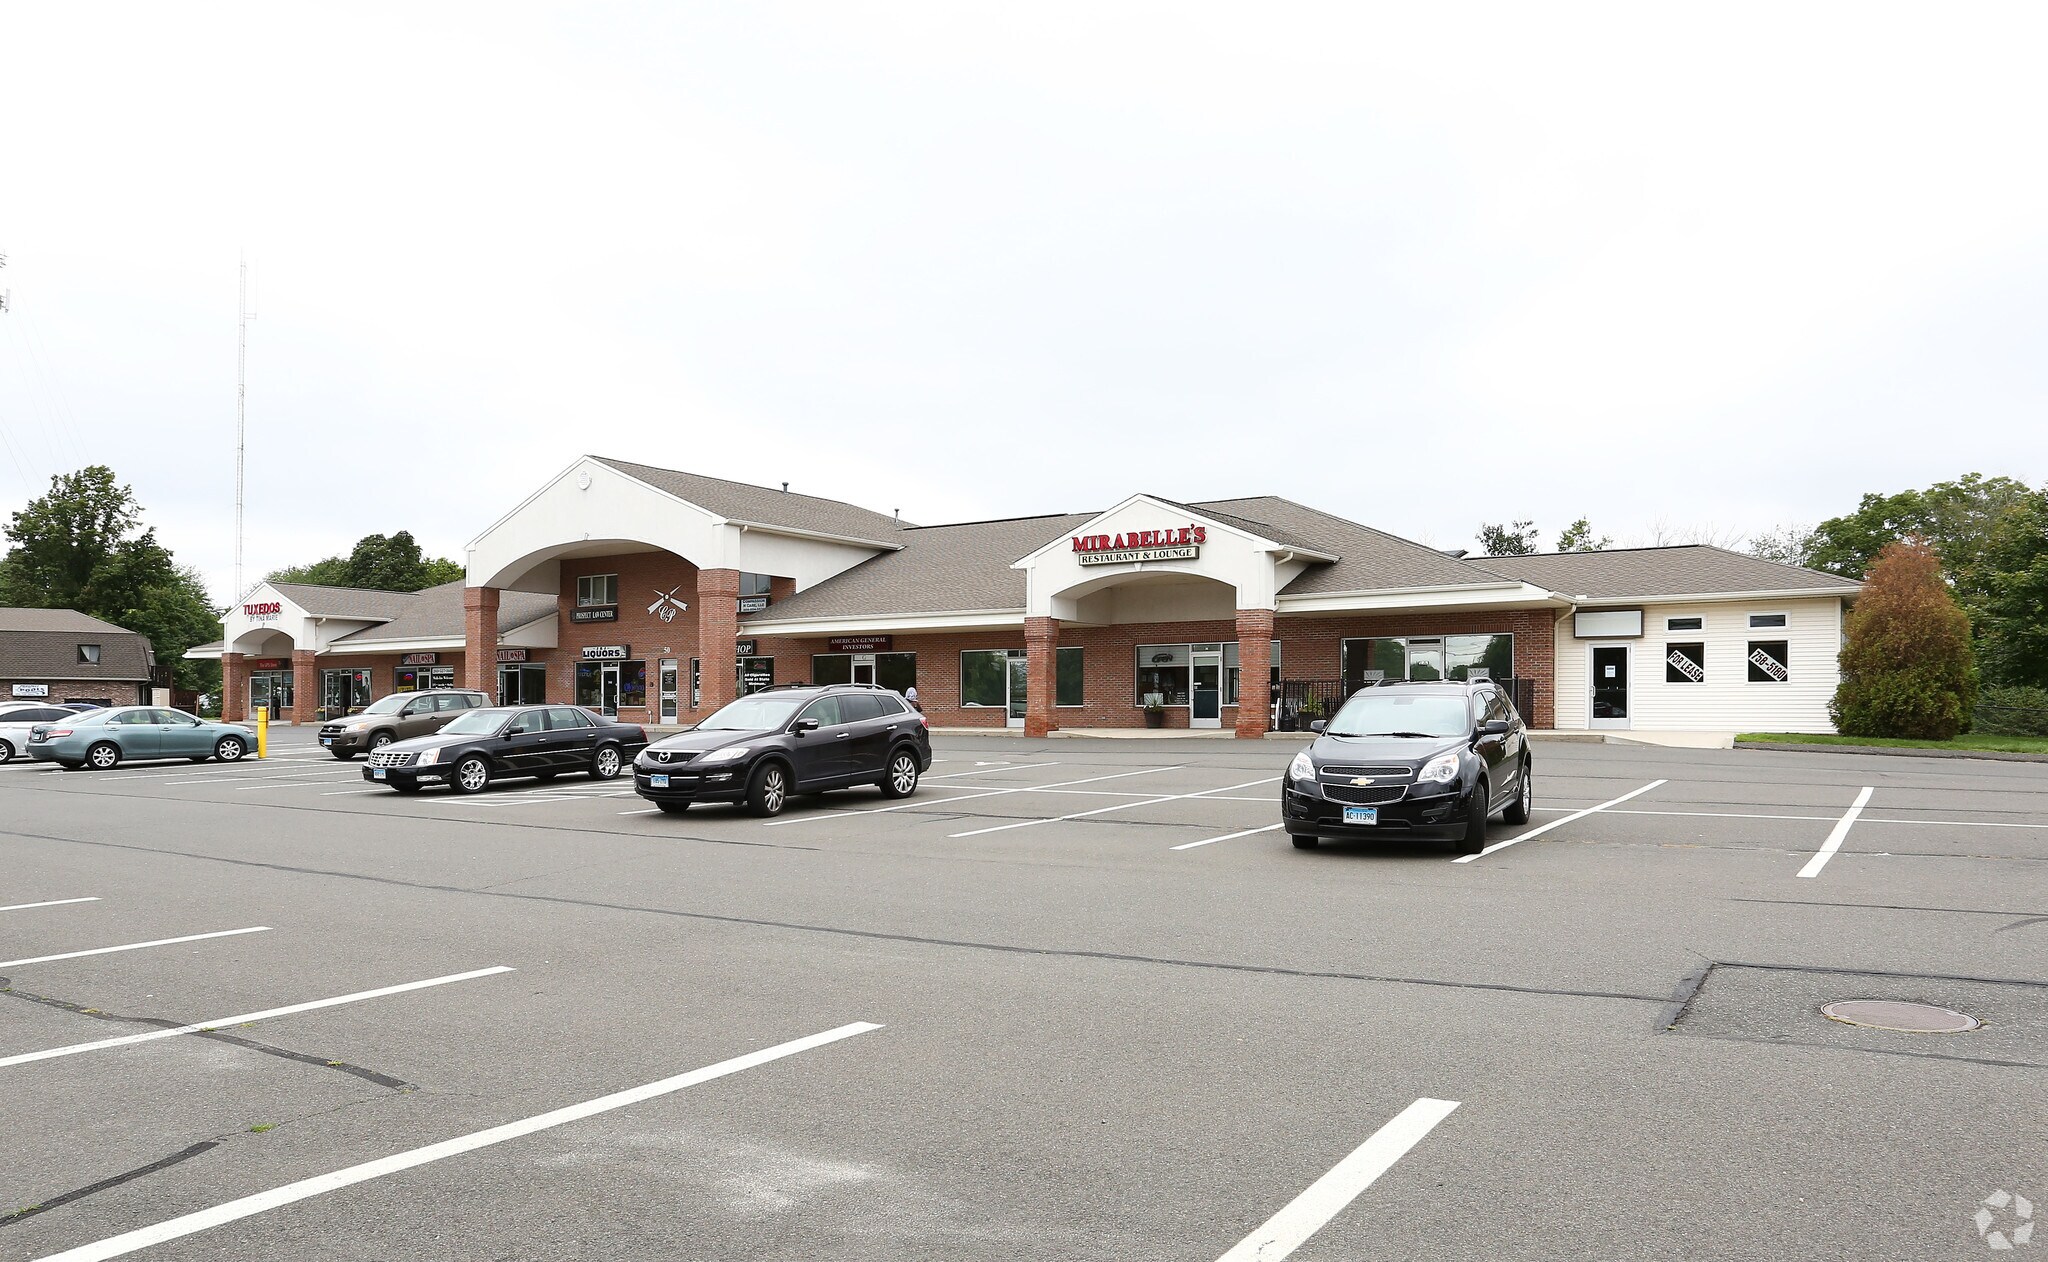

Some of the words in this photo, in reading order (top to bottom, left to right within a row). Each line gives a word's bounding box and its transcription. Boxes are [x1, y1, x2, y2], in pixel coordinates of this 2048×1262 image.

[1072, 524, 1206, 552] MIRABELLE'S
[1082, 552, 1139, 563] RESTAURANT
[1143, 551, 1151, 559] &
[1154, 548, 1192, 559] LOUNGE
[243, 602, 280, 615] TUXEDOS
[514, 651, 525, 660] SPA
[583, 650, 620, 658] LIQUORS
[1669, 652, 1684, 667] FOR
[1680, 661, 1703, 680] LEASE
[1751, 651, 1786, 679] 758-5180
